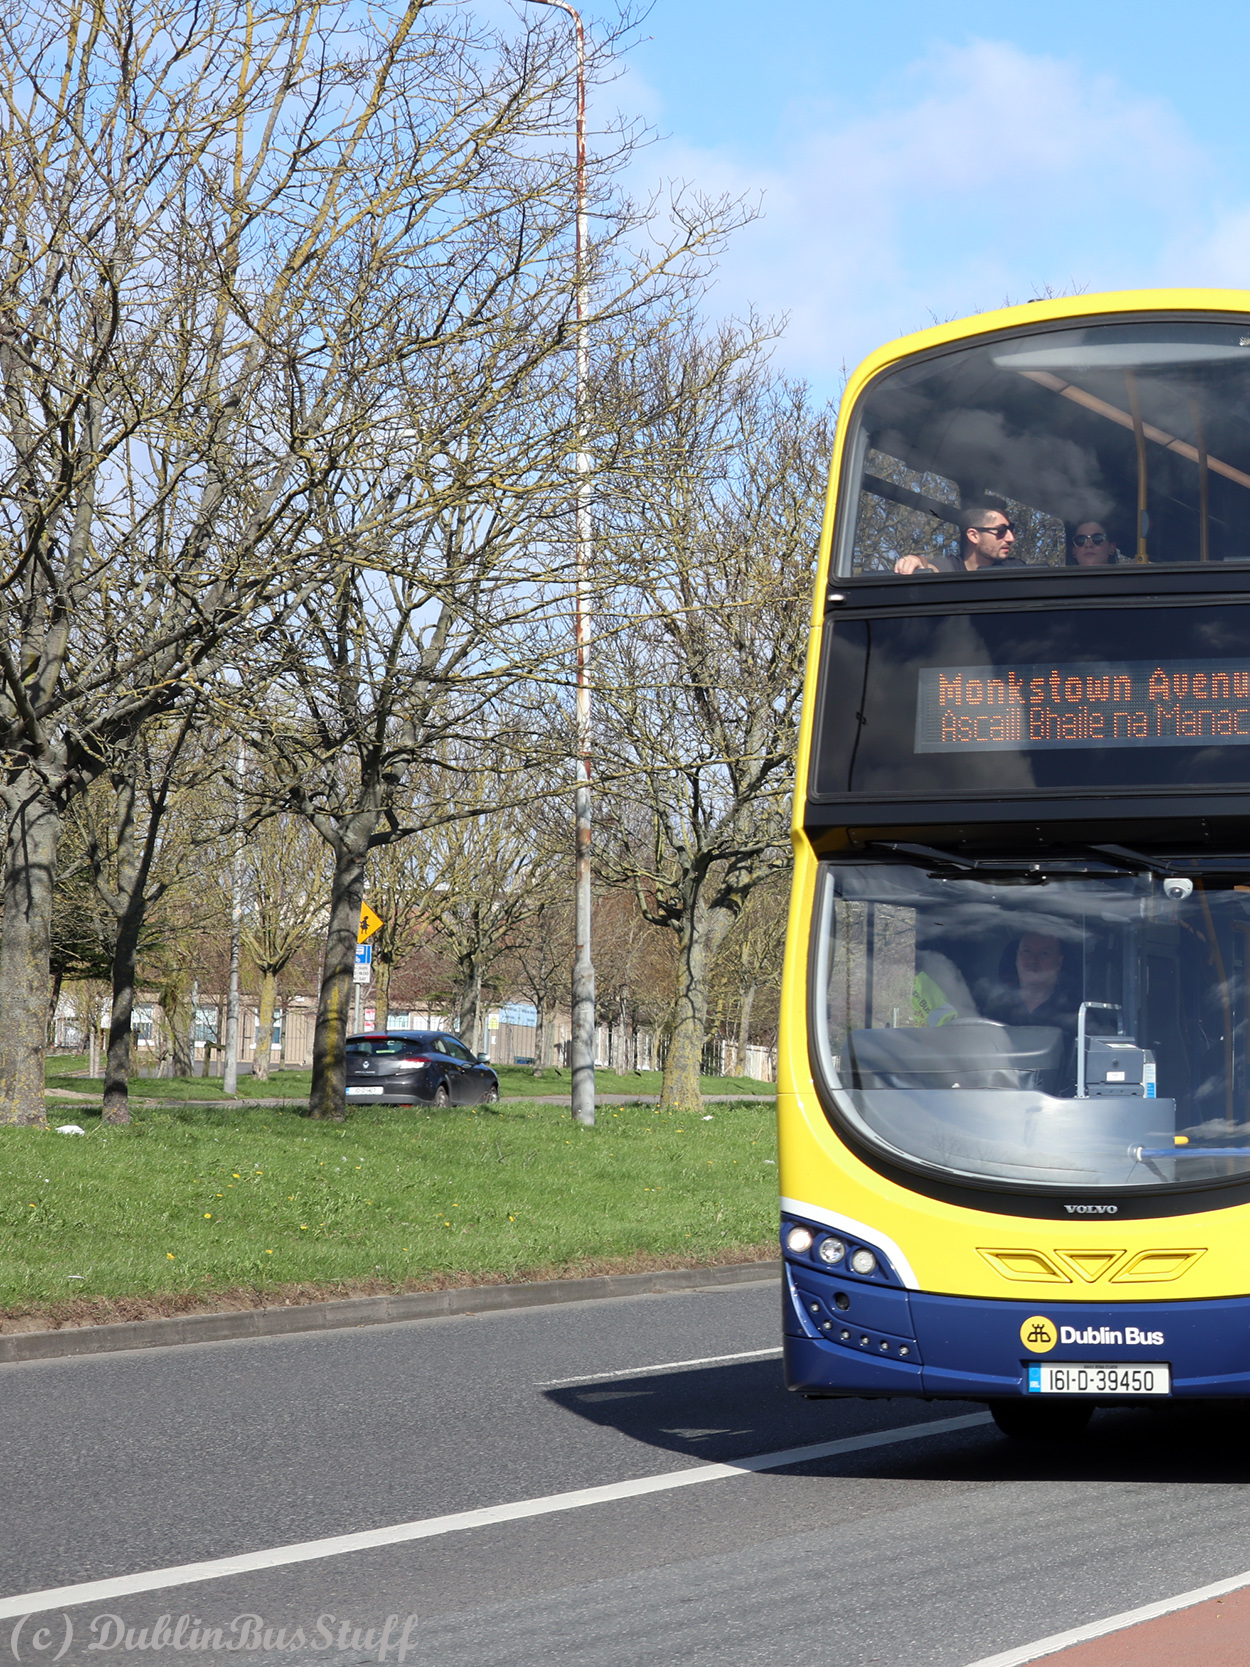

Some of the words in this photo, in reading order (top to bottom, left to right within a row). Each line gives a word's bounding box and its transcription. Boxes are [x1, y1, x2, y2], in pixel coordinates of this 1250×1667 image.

[939, 671, 1132, 706] Monkstown
[941, 707, 1022, 742] Ascaill
[1029, 706, 1105, 740] Bhaile
[1113, 711, 1149, 738] na
[1064, 1205, 1118, 1214] VOLVO
[1060, 1326, 1123, 1345] Dublin
[1125, 1327, 1164, 1345] Bus
[1050, 1370, 1154, 1391] 161-D-39450
